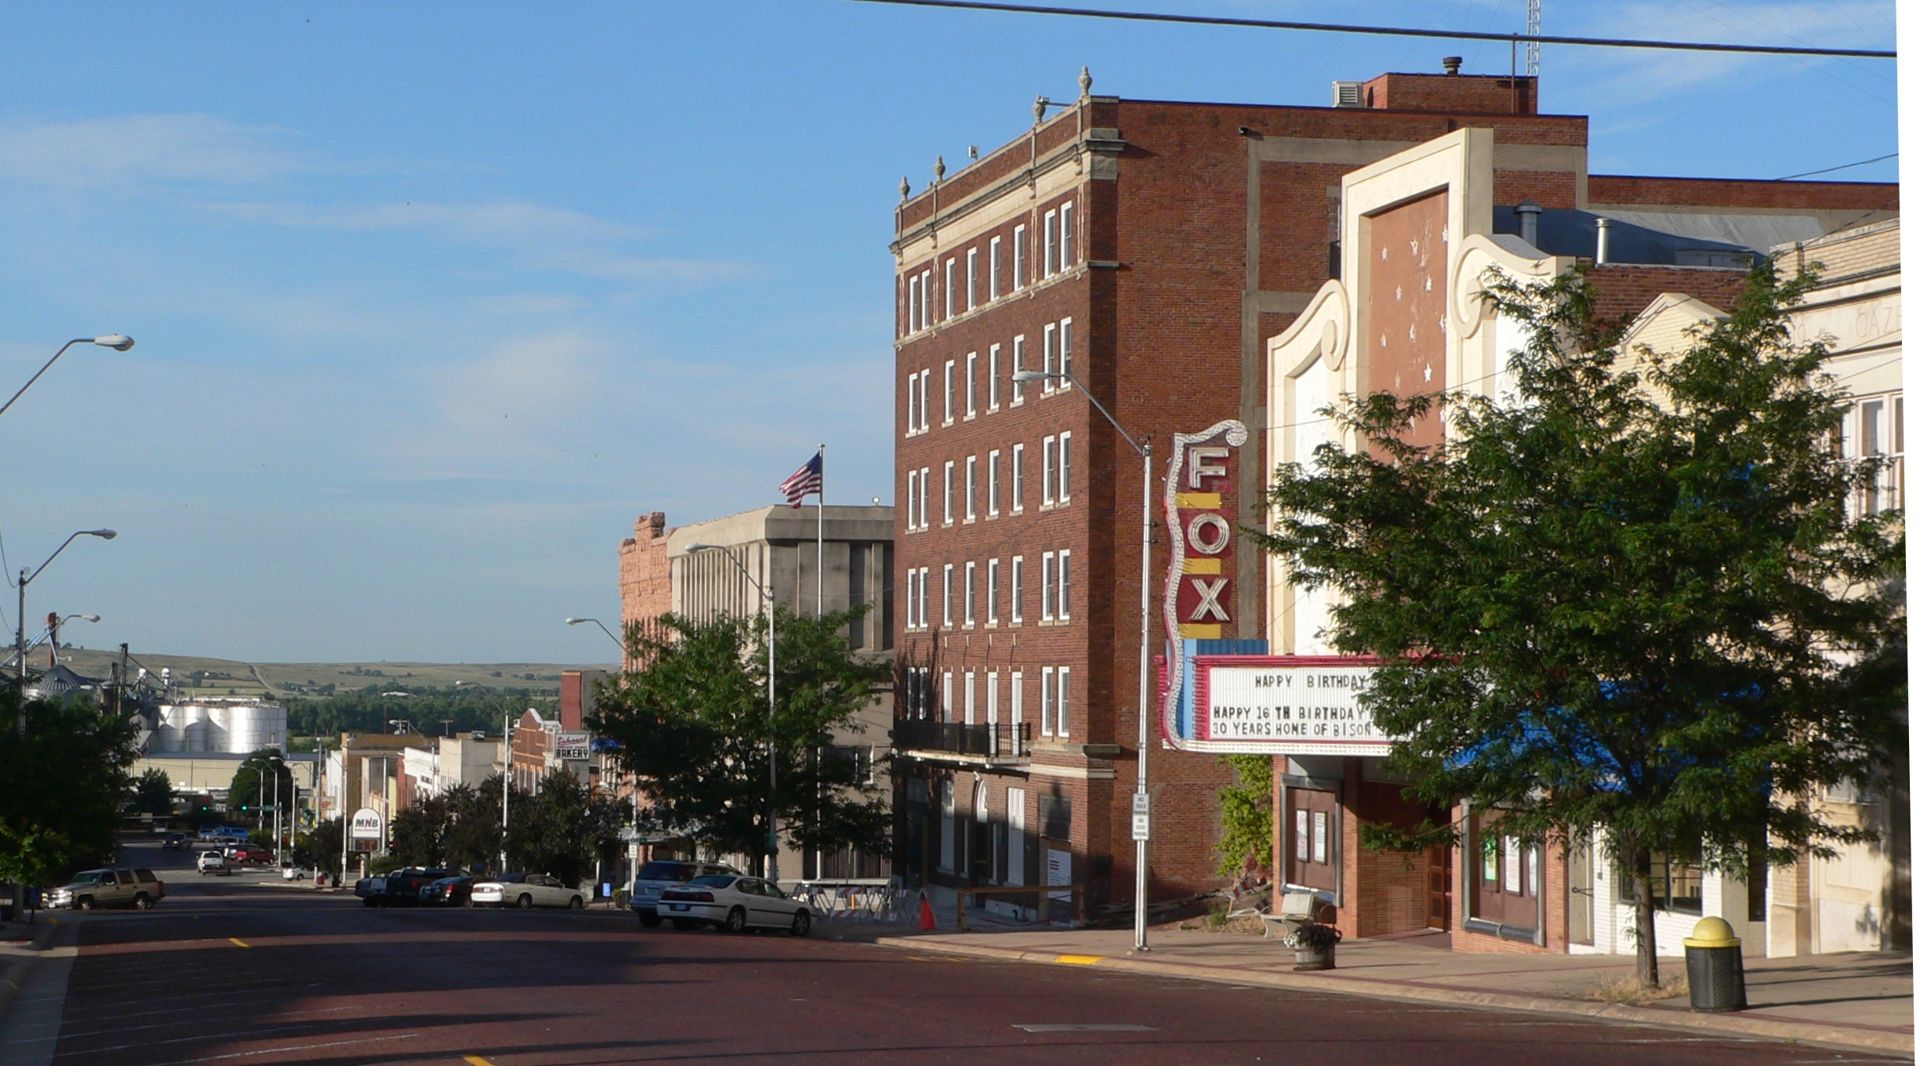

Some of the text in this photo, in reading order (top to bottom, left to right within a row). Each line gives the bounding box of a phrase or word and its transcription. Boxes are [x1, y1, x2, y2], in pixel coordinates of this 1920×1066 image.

[1188, 447, 1230, 621] FOX
[1255, 675, 1366, 689] HAPPY BIRTHDAY
[1213, 706, 1251, 720] HAPPY
[1256, 706, 1270, 720] 16
[1275, 706, 1291, 720] TH
[1299, 706, 1364, 721] BIRTHDAY
[1212, 722, 1227, 735] 30
[1233, 722, 1271, 735] YEARS
[1275, 723, 1307, 736] HOME
[1313, 723, 1327, 736] OF
[1333, 723, 1371, 737] BISON
[556, 748, 588, 758] BAKERY
[355, 817, 378, 828] MNB
